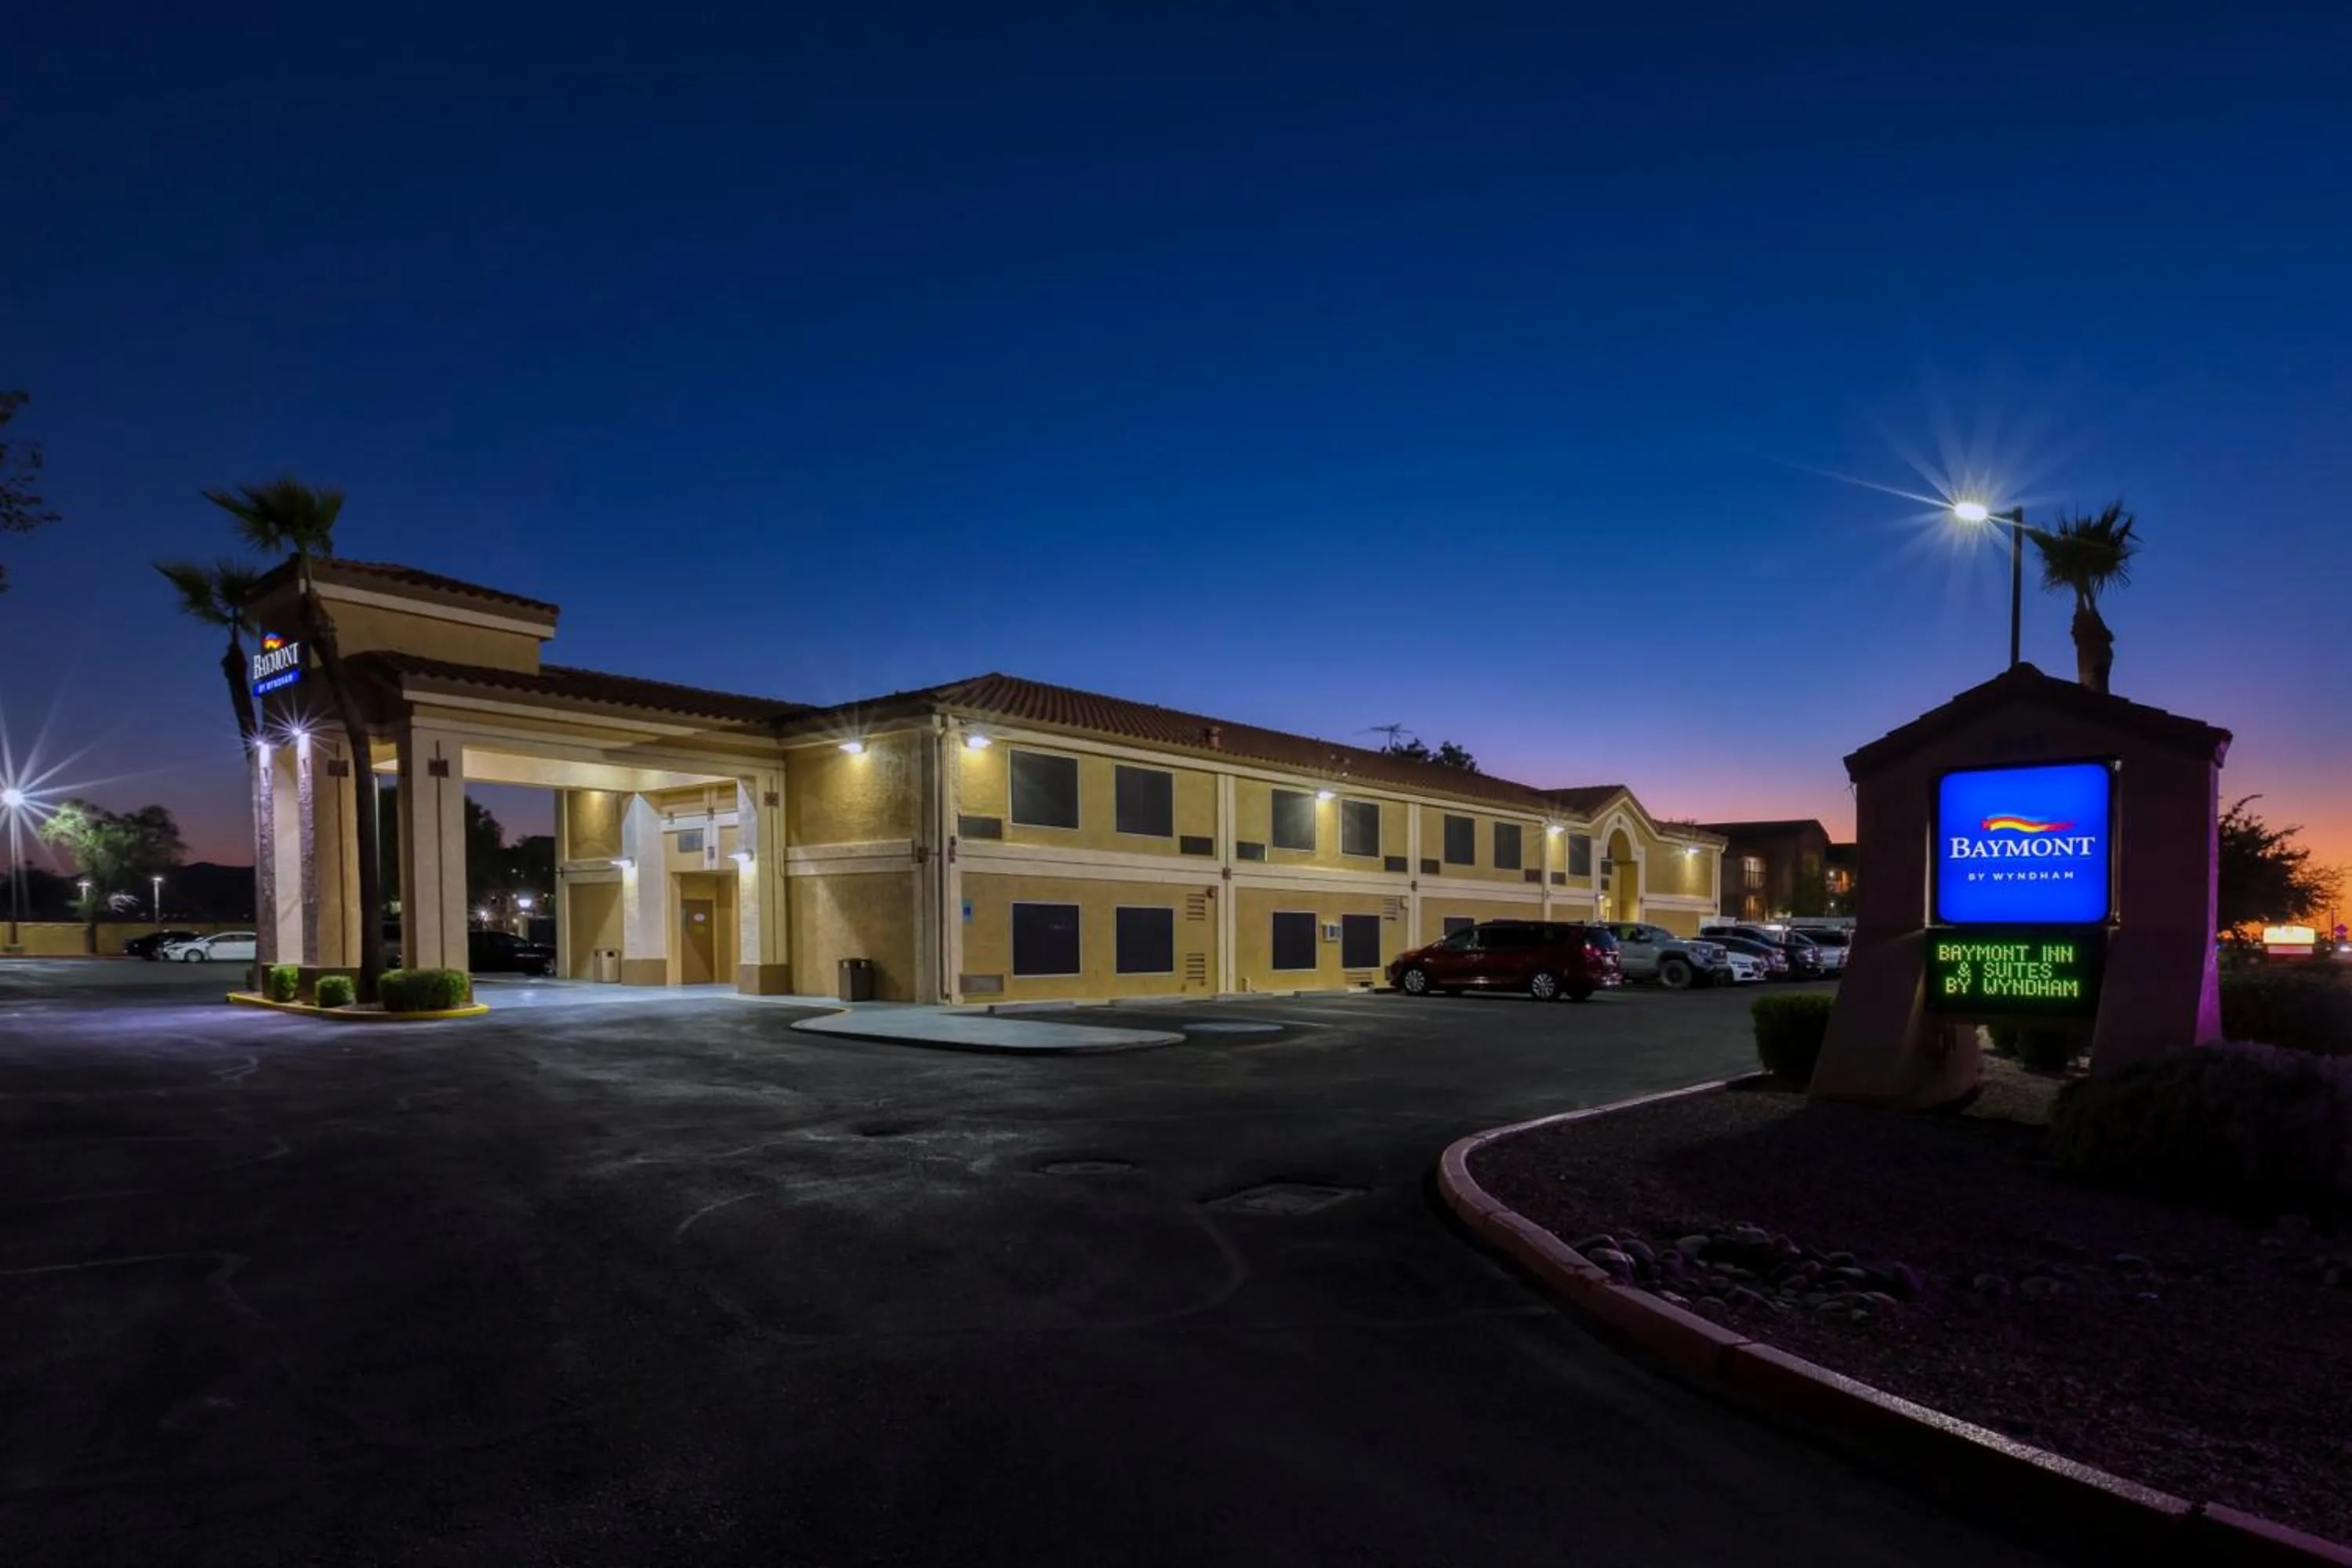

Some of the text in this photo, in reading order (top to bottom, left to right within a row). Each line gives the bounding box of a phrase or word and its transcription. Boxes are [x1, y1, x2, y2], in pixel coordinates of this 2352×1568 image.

[253, 642, 299, 680] BAYMONT
[1950, 837, 2096, 858] BAYMONT
[1968, 871, 2074, 881] BY WYNDHAM
[1938, 945, 2074, 963] BAYMONT INN
[1958, 961, 2053, 979] & SUITES
[1945, 977, 2078, 997] BY WYNDHAM
